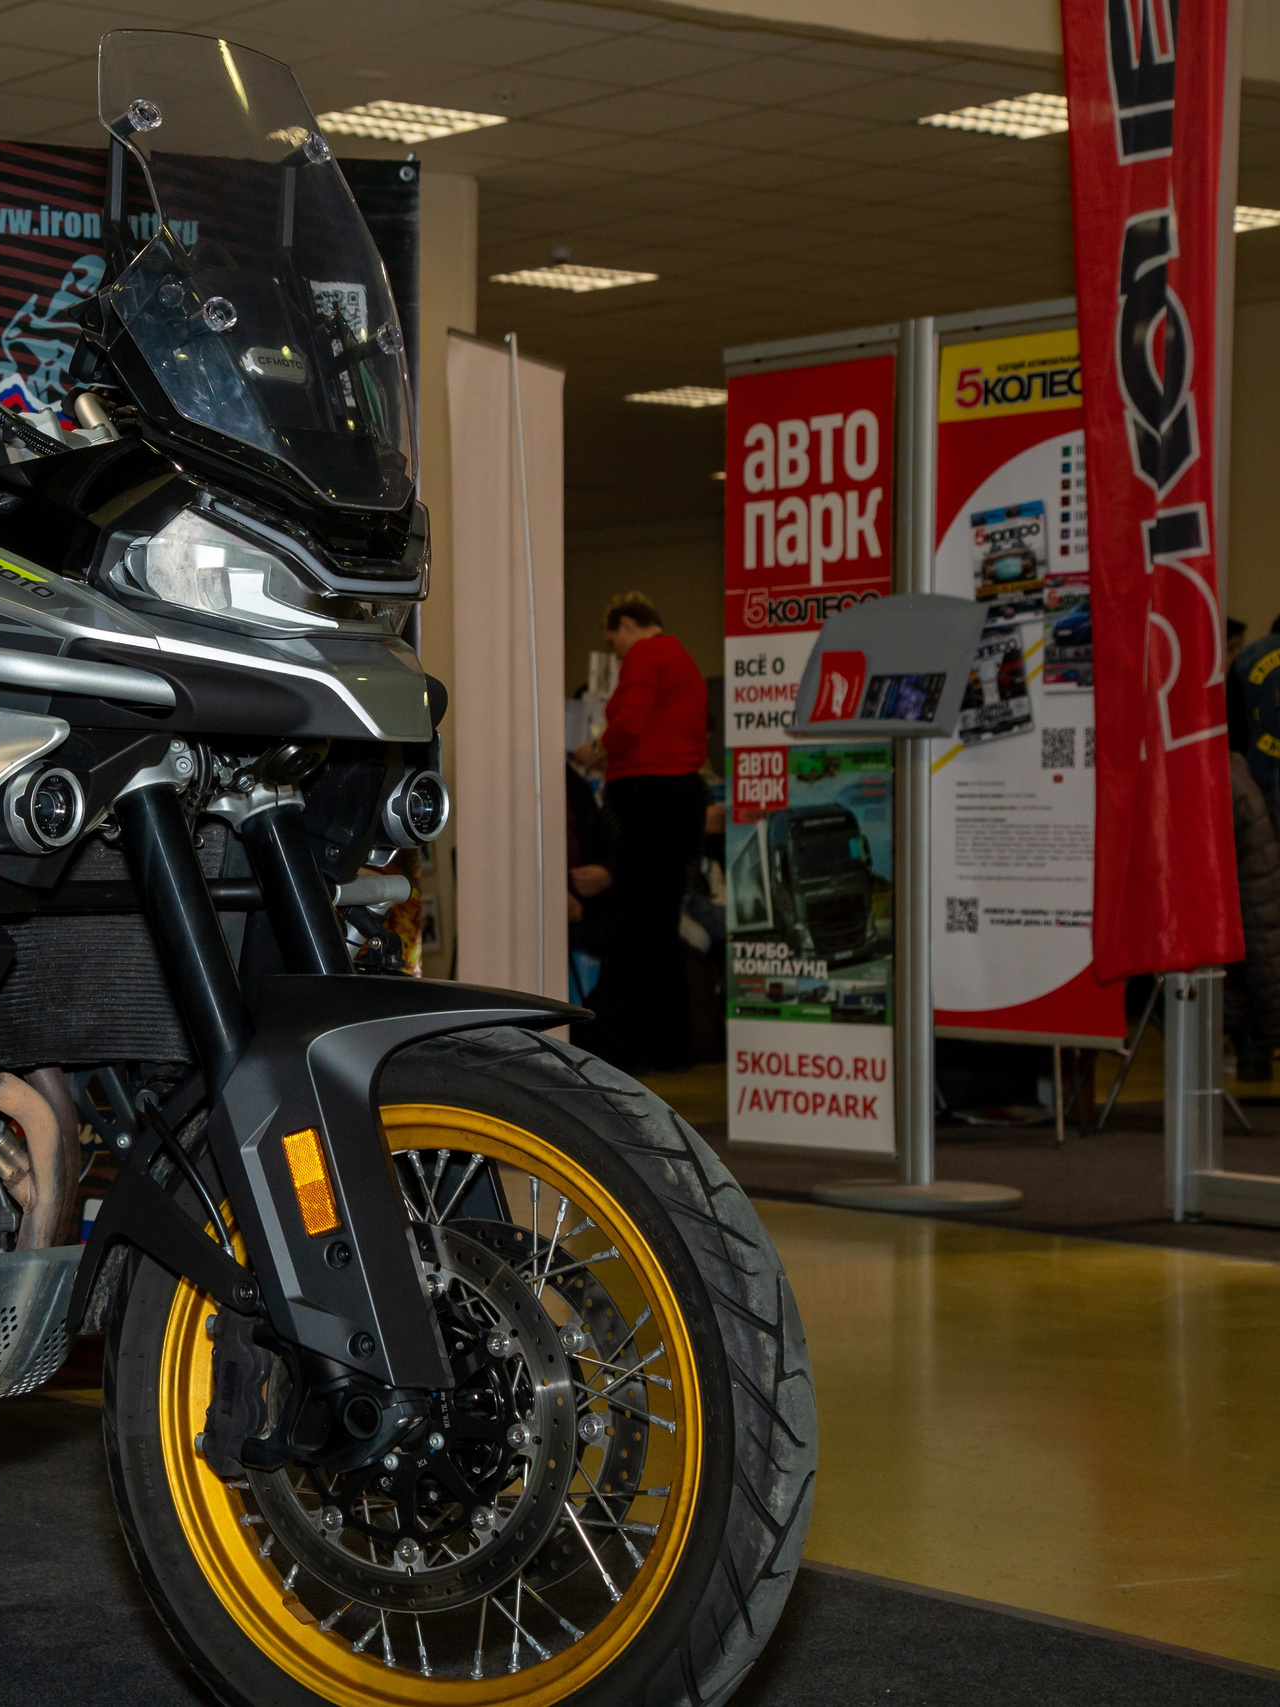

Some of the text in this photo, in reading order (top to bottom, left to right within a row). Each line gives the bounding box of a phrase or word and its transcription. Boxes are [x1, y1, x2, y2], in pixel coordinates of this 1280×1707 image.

[257, 356, 303, 370] CFMOTO
[735, 654, 785, 677] ВСЁ О
[733, 942, 794, 960] ТУРБО-
[733, 959, 829, 979] КОМПАУНД
[736, 1050, 888, 1083] 5KOLESO.RU
[736, 1086, 879, 1121] /AVTOPARK
[138, 1441, 155, 1497] RADIAL
